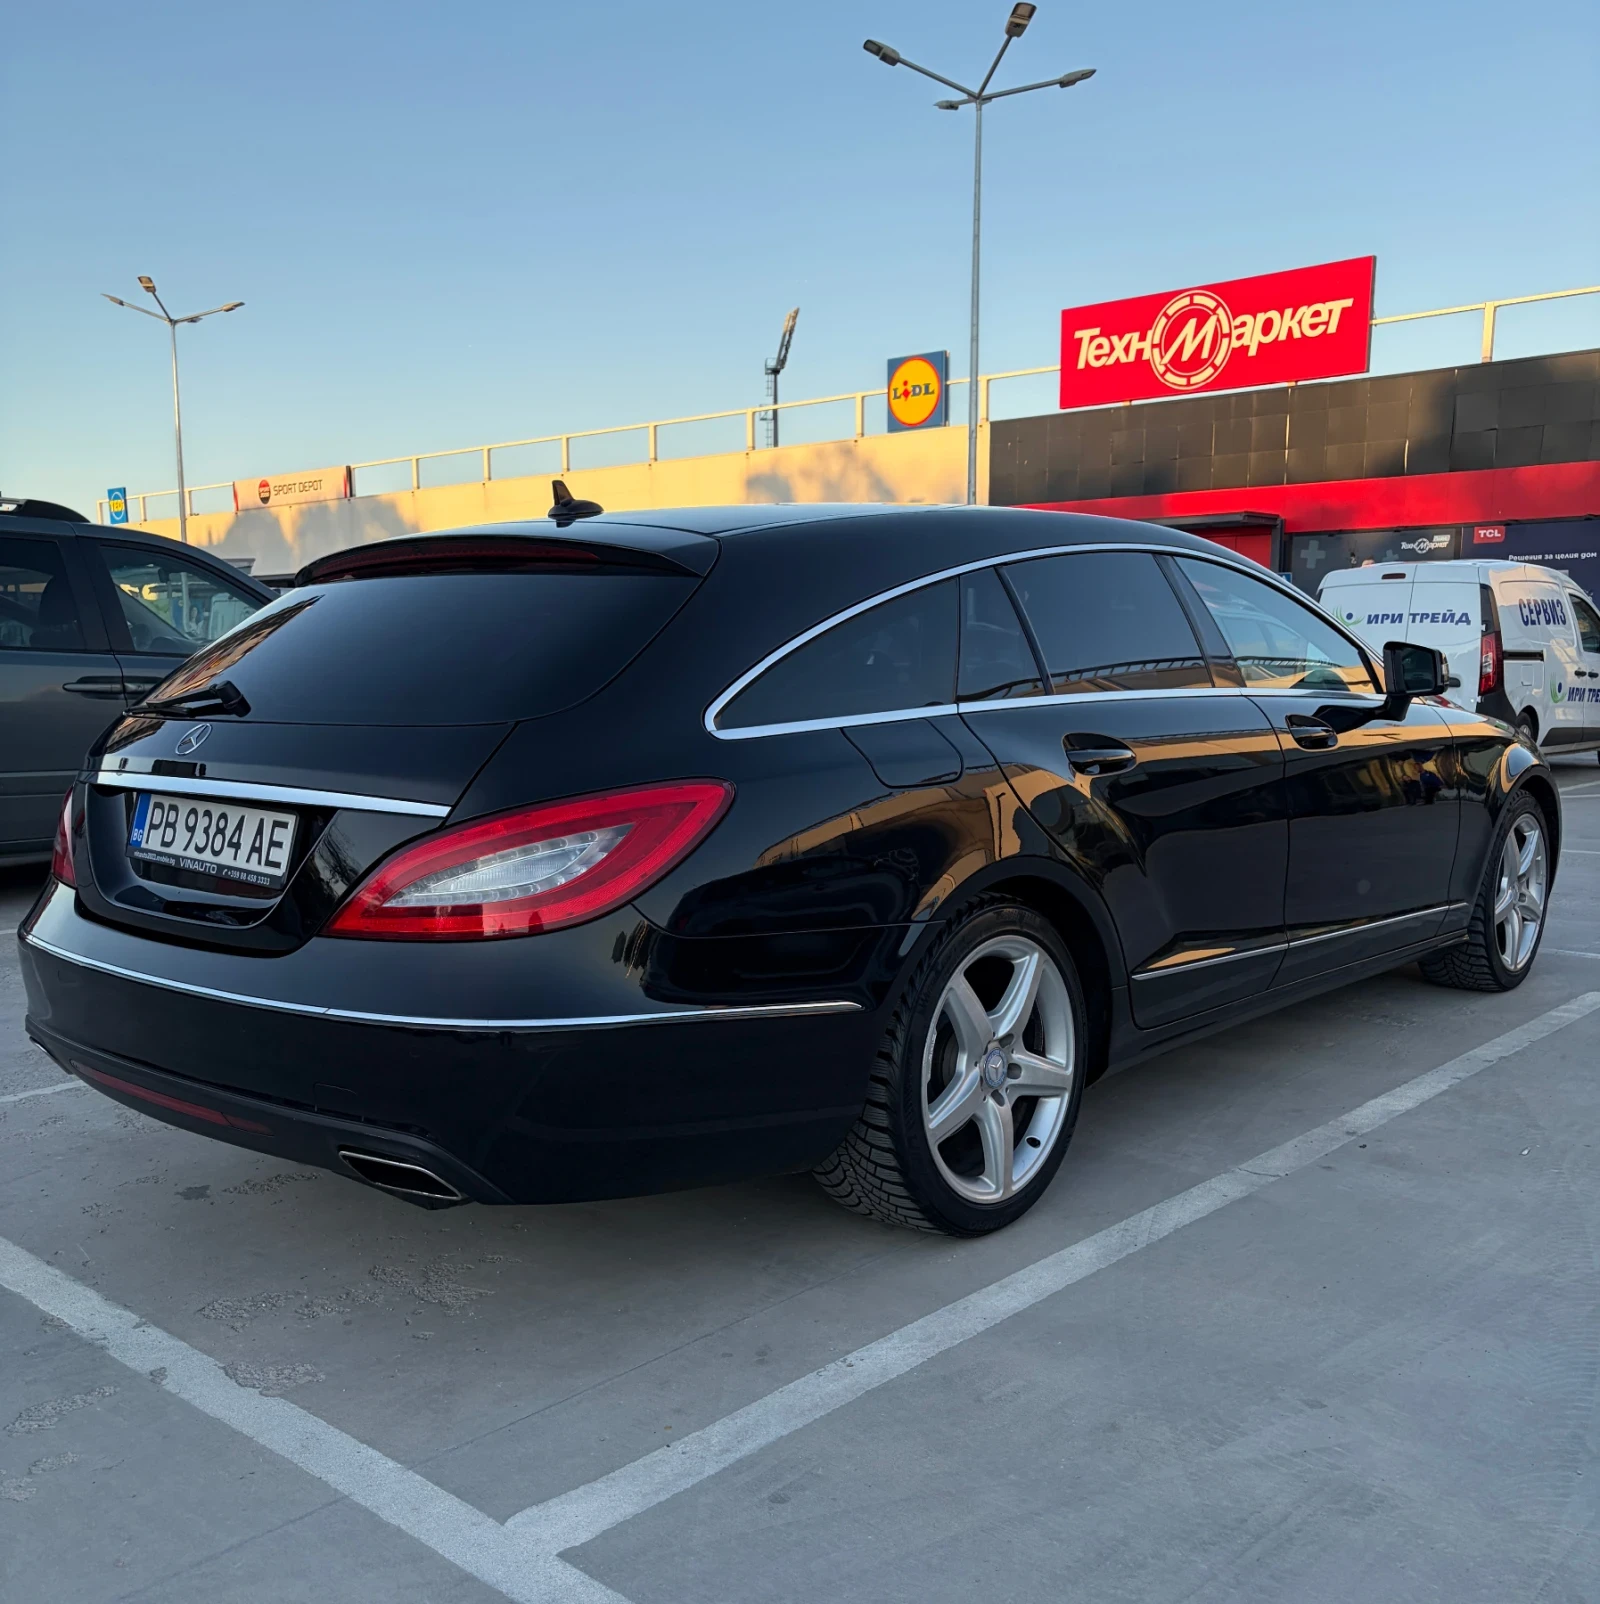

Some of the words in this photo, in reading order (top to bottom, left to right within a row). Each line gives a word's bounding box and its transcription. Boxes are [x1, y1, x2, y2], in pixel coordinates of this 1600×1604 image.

[273, 483, 297, 496] SPORT
[299, 480, 322, 493] DEPOT
[1478, 529, 1501, 538] TCL
[1555, 552, 1579, 560] целия
[1366, 613, 1404, 625] ИРИ
[1409, 609, 1472, 626] ТРЕЙД
[1518, 597, 1567, 628] СЕРВИЗ
[1567, 686, 1586, 702] ИРИ
[1587, 688, 1600, 703] ТРЕ
[132, 828, 144, 842] BG
[145, 801, 180, 848] PB
[183, 807, 246, 861] 9384
[245, 817, 290, 869] AE
[179, 858, 218, 873] VINAUTO
[228, 869, 240, 879] +359
